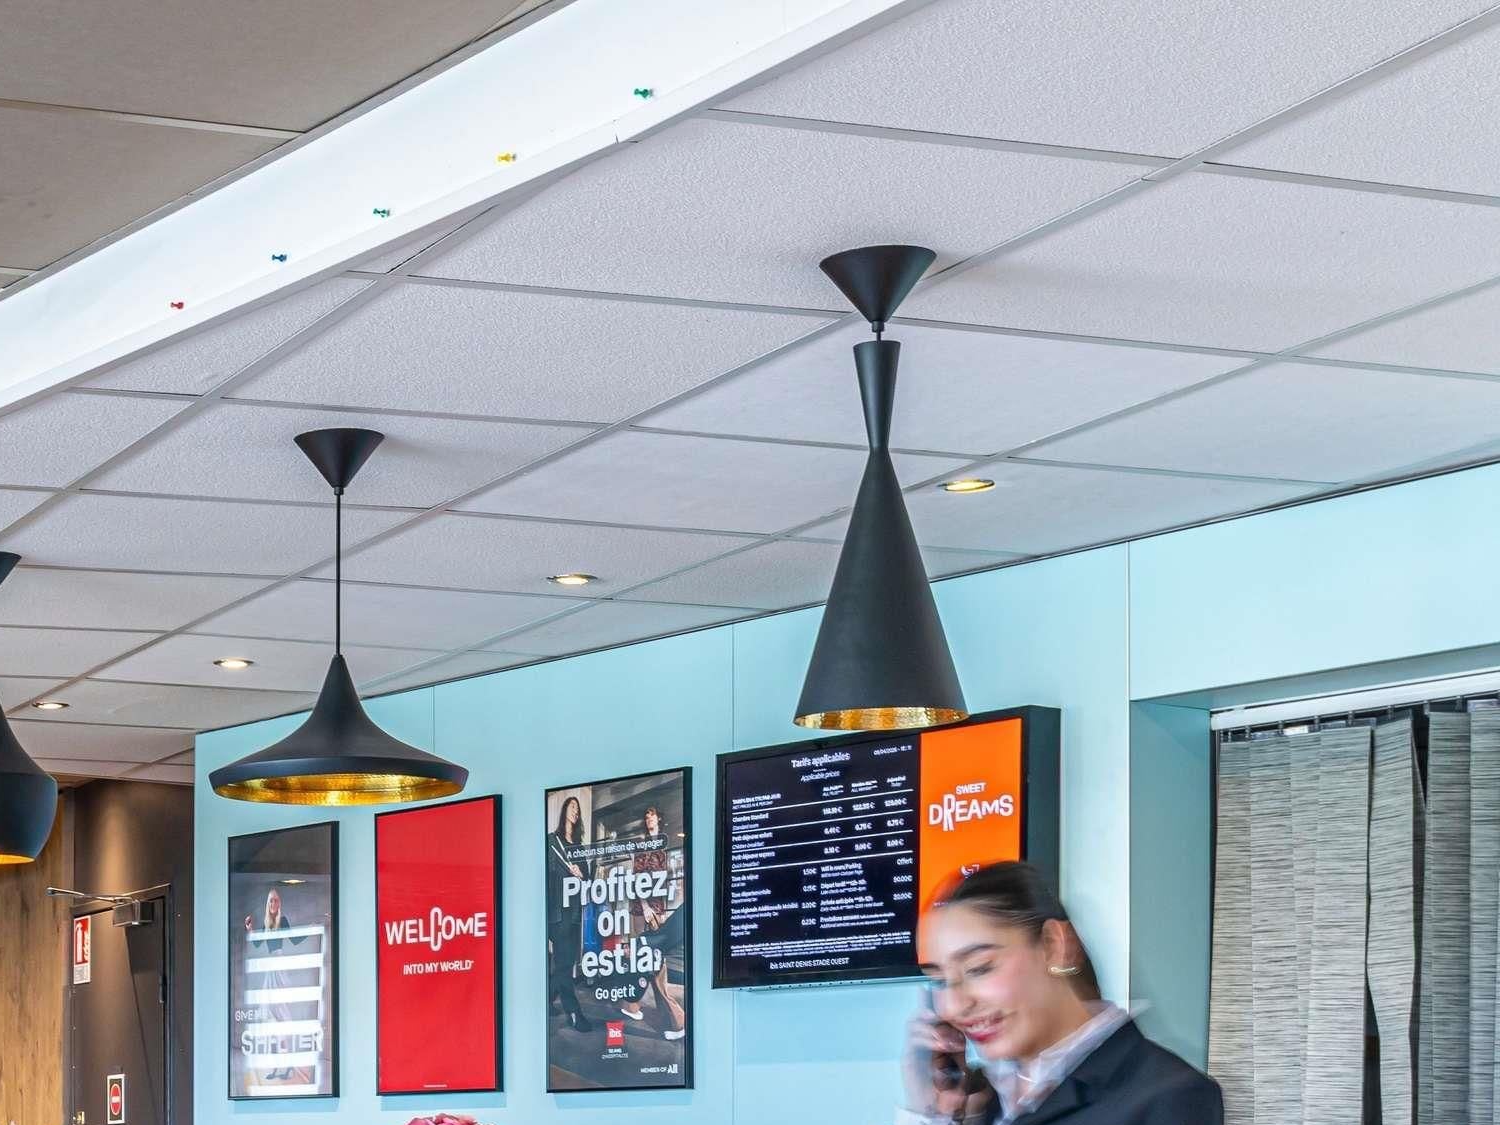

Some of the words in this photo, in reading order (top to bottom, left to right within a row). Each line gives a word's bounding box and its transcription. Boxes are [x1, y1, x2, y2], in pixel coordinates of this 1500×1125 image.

[790, 756, 811, 768] Tarifs
[812, 751, 851, 766] applicables
[955, 782, 987, 795] SWEET
[928, 793, 1014, 832] DREAMS
[573, 846, 596, 859] chacun
[596, 846, 604, 855] sa
[605, 842, 625, 854] raison
[626, 840, 635, 851] de
[635, 838, 663, 851] voyager
[385, 907, 488, 952] WELCOME
[597, 909, 631, 937] on
[403, 963, 424, 975] INTO
[425, 961, 439, 973] MY
[581, 943, 625, 979] est
[779, 961, 795, 969] SAINT
[795, 960, 812, 968] DENIS
[813, 958, 830, 967] STADE
[831, 957, 850, 965] OUEST
[595, 987, 608, 1000] Go
[610, 986, 628, 1002] get
[628, 984, 636, 997] it
[608, 1028, 622, 1038] ibis
